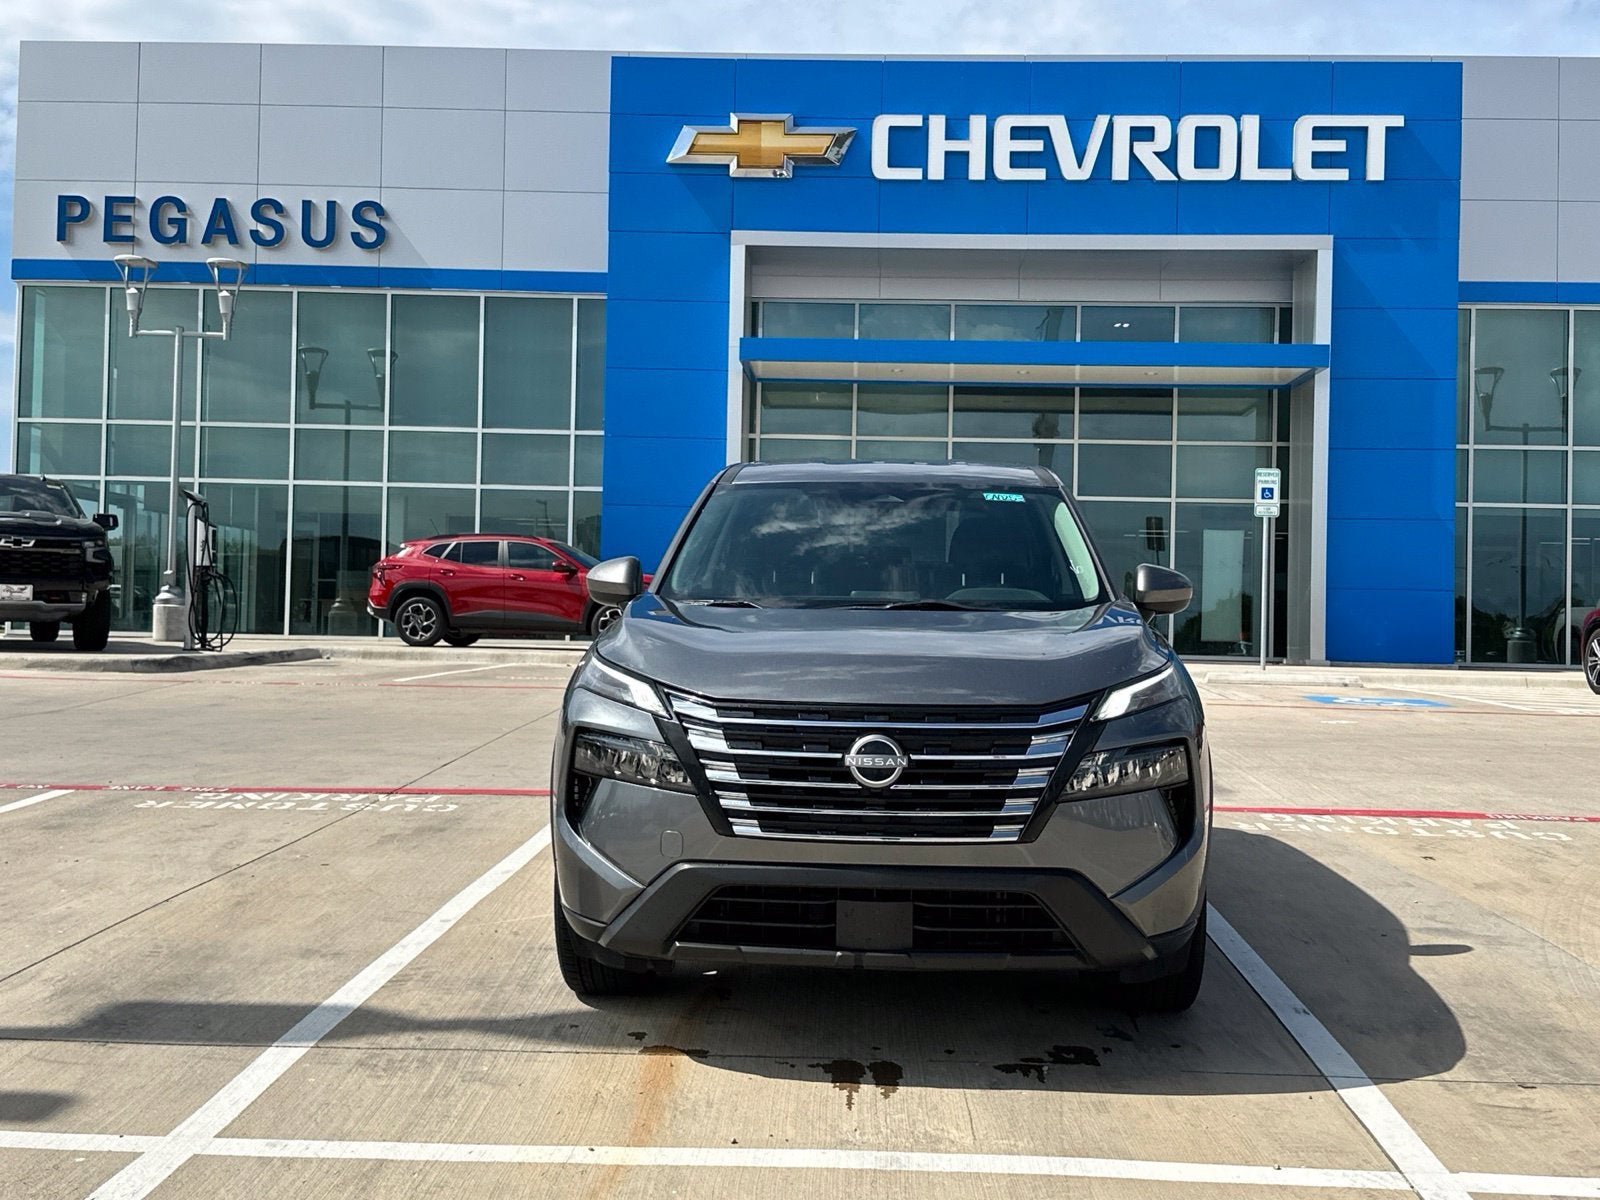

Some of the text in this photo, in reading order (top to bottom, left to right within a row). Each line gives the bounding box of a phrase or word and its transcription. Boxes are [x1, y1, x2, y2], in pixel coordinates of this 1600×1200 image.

[871, 114, 1405, 182] CHEVROLET
[56, 194, 390, 250] PEGASUS
[846, 757, 906, 766] NISSAN
[193, 793, 443, 803] PARKING
[133, 800, 459, 812] CUSTOMER
[1259, 813, 1520, 830] PARKING
